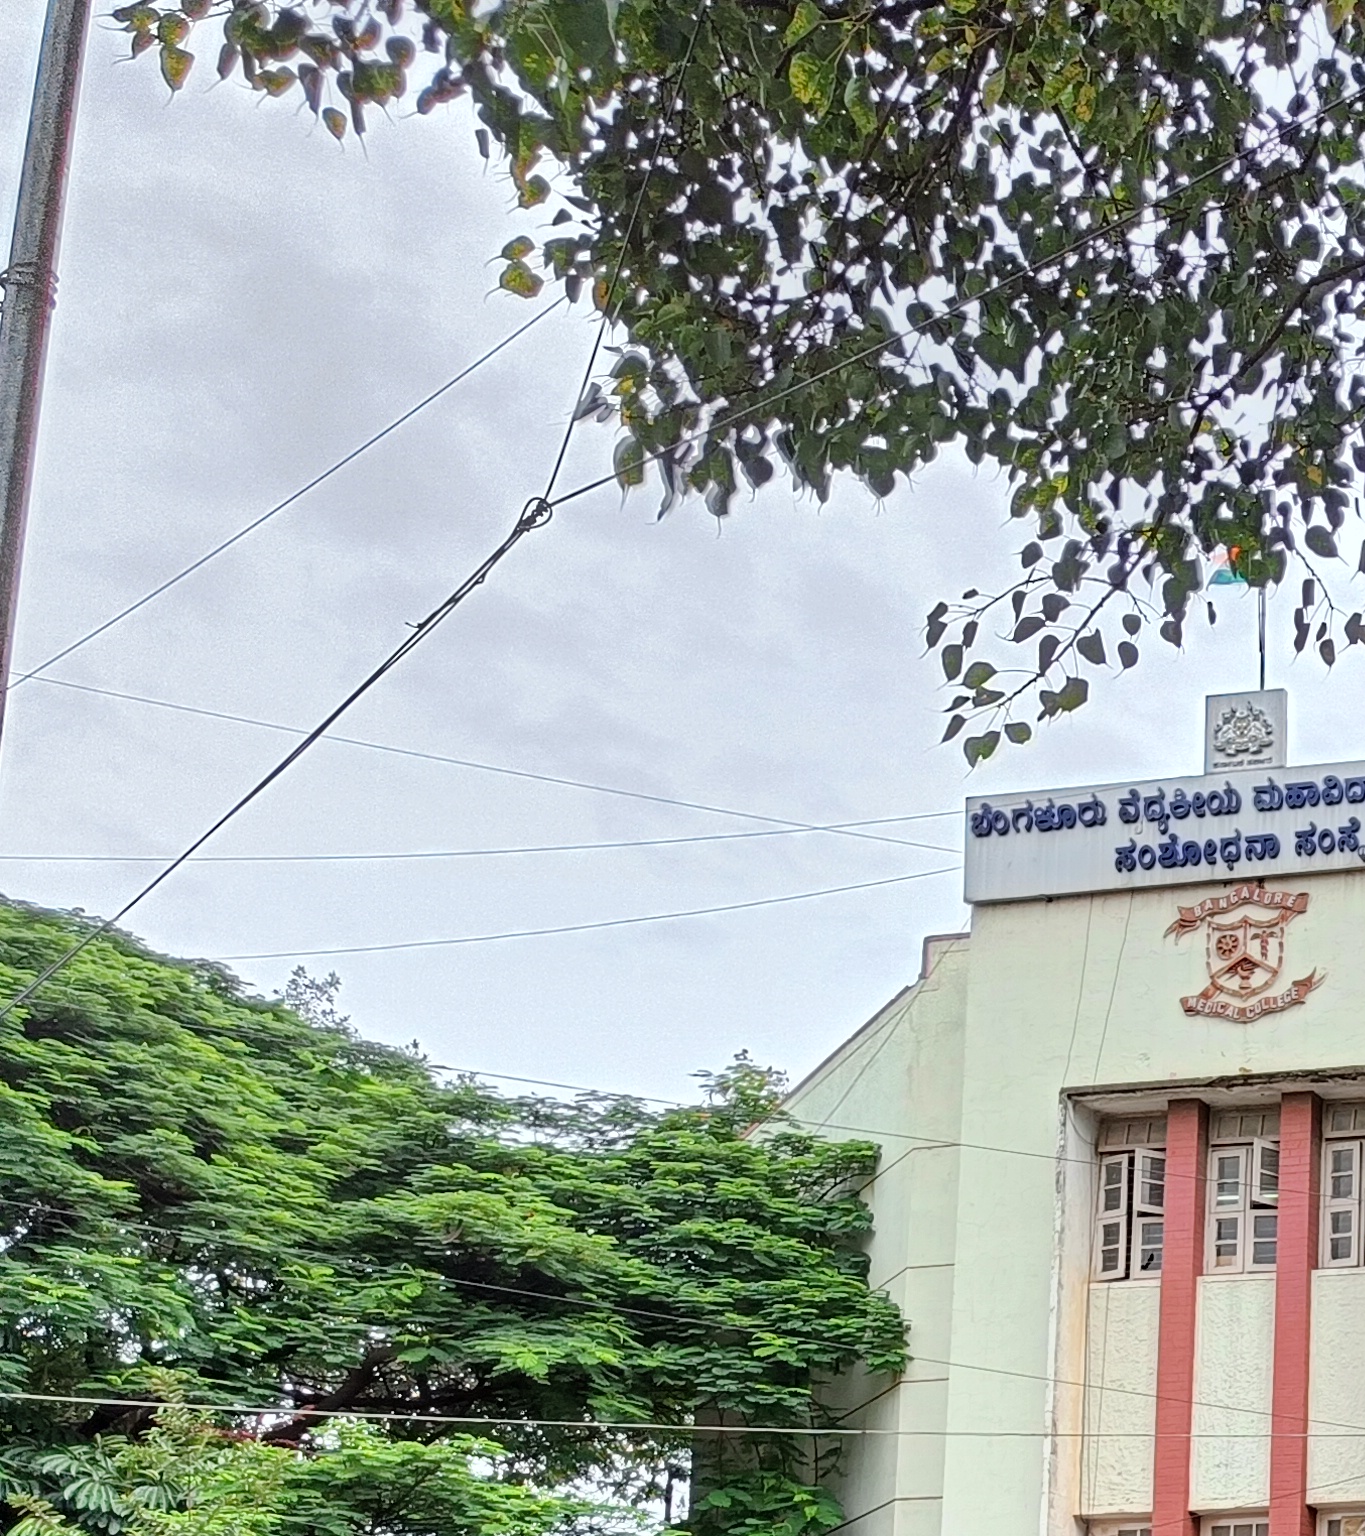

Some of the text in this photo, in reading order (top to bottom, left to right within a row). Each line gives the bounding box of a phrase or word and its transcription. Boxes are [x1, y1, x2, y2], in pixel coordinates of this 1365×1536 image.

[971, 792, 1107, 838] ಬೆಂಗಳೂರು
[1115, 827, 1280, 873] ಸಂಶೋಧನಾ
[1194, 886, 1297, 918] BANGALORE
[1187, 986, 1300, 1020] MEDICAL COLLEGE
